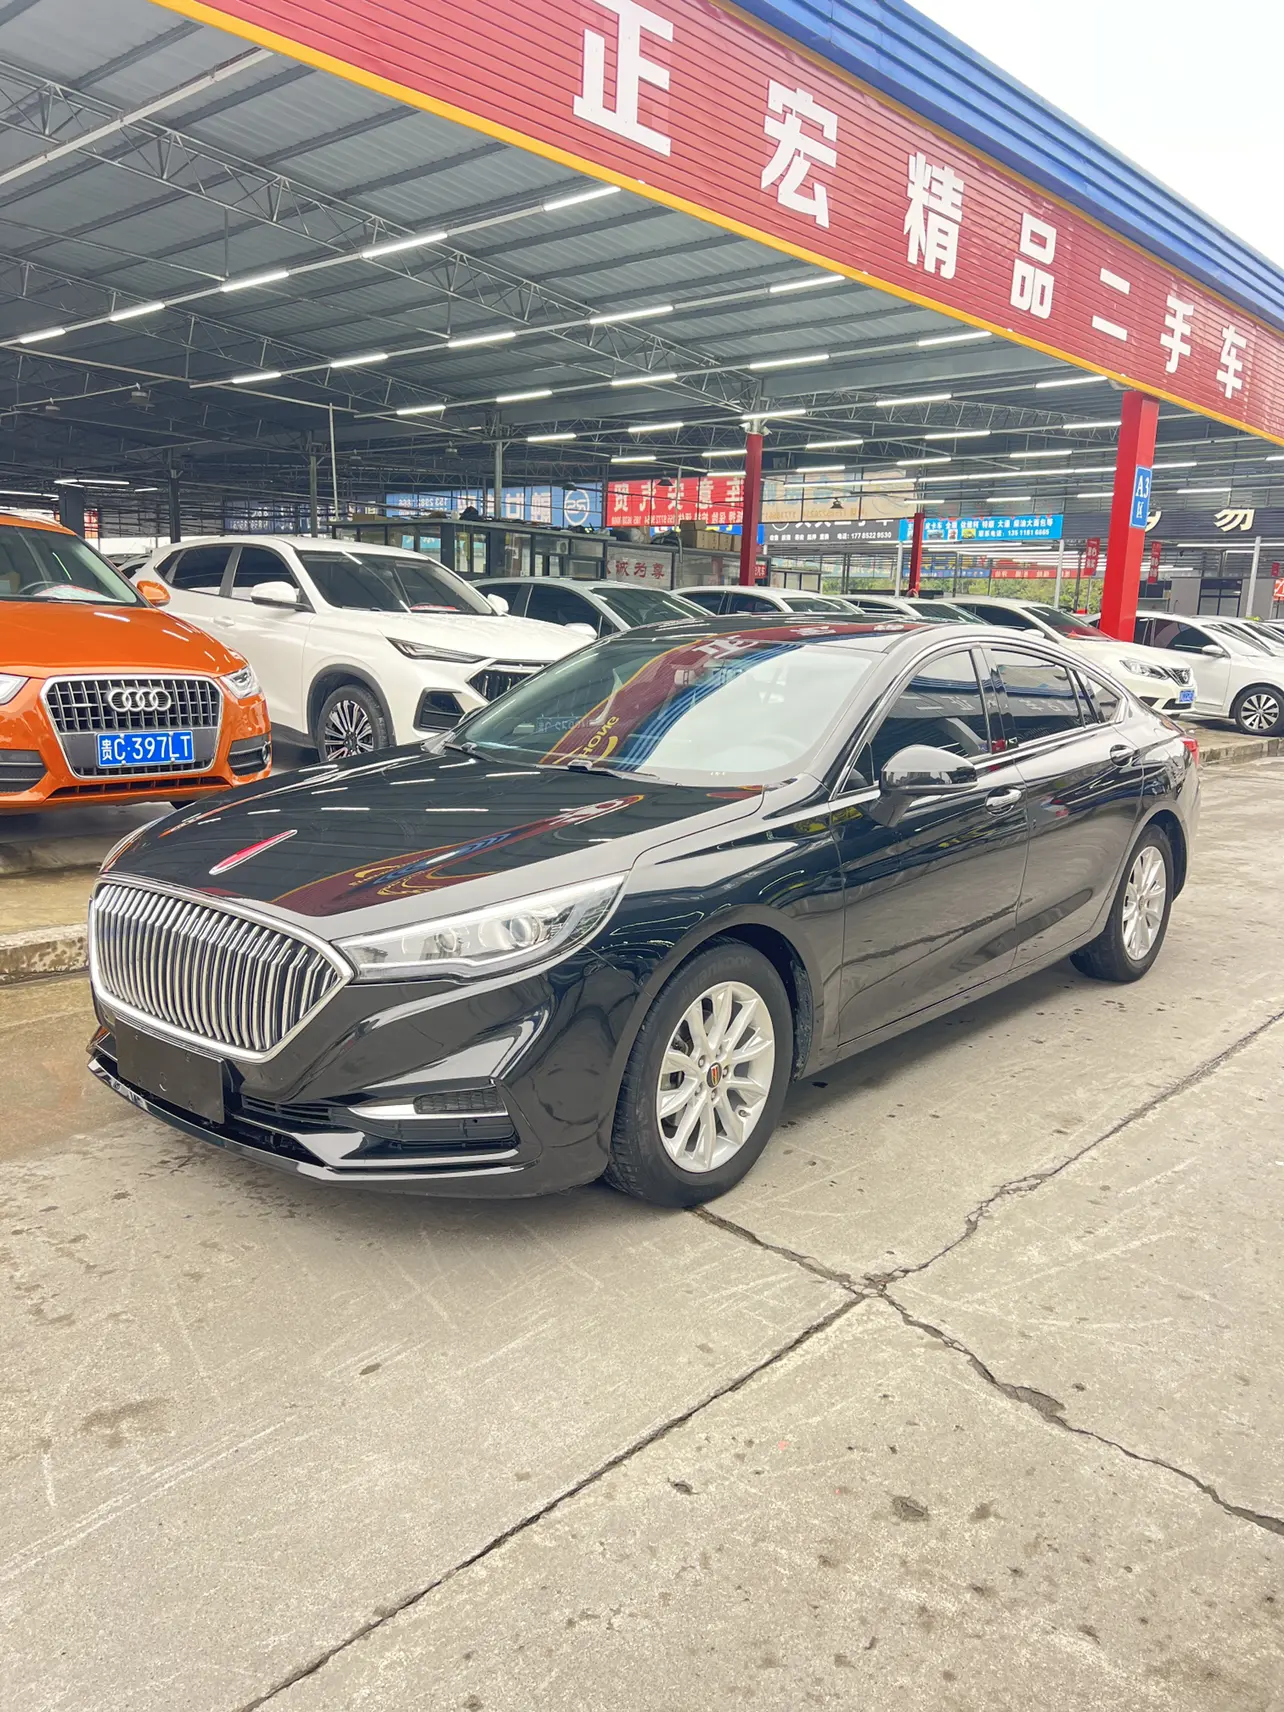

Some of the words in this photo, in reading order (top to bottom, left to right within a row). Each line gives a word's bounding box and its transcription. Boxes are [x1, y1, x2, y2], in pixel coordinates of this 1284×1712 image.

[573, 0, 1248, 399] 正宏精品二手车
[1135, 475, 1150, 499] A3
[101, 735, 191, 761] 贵C·397LT
